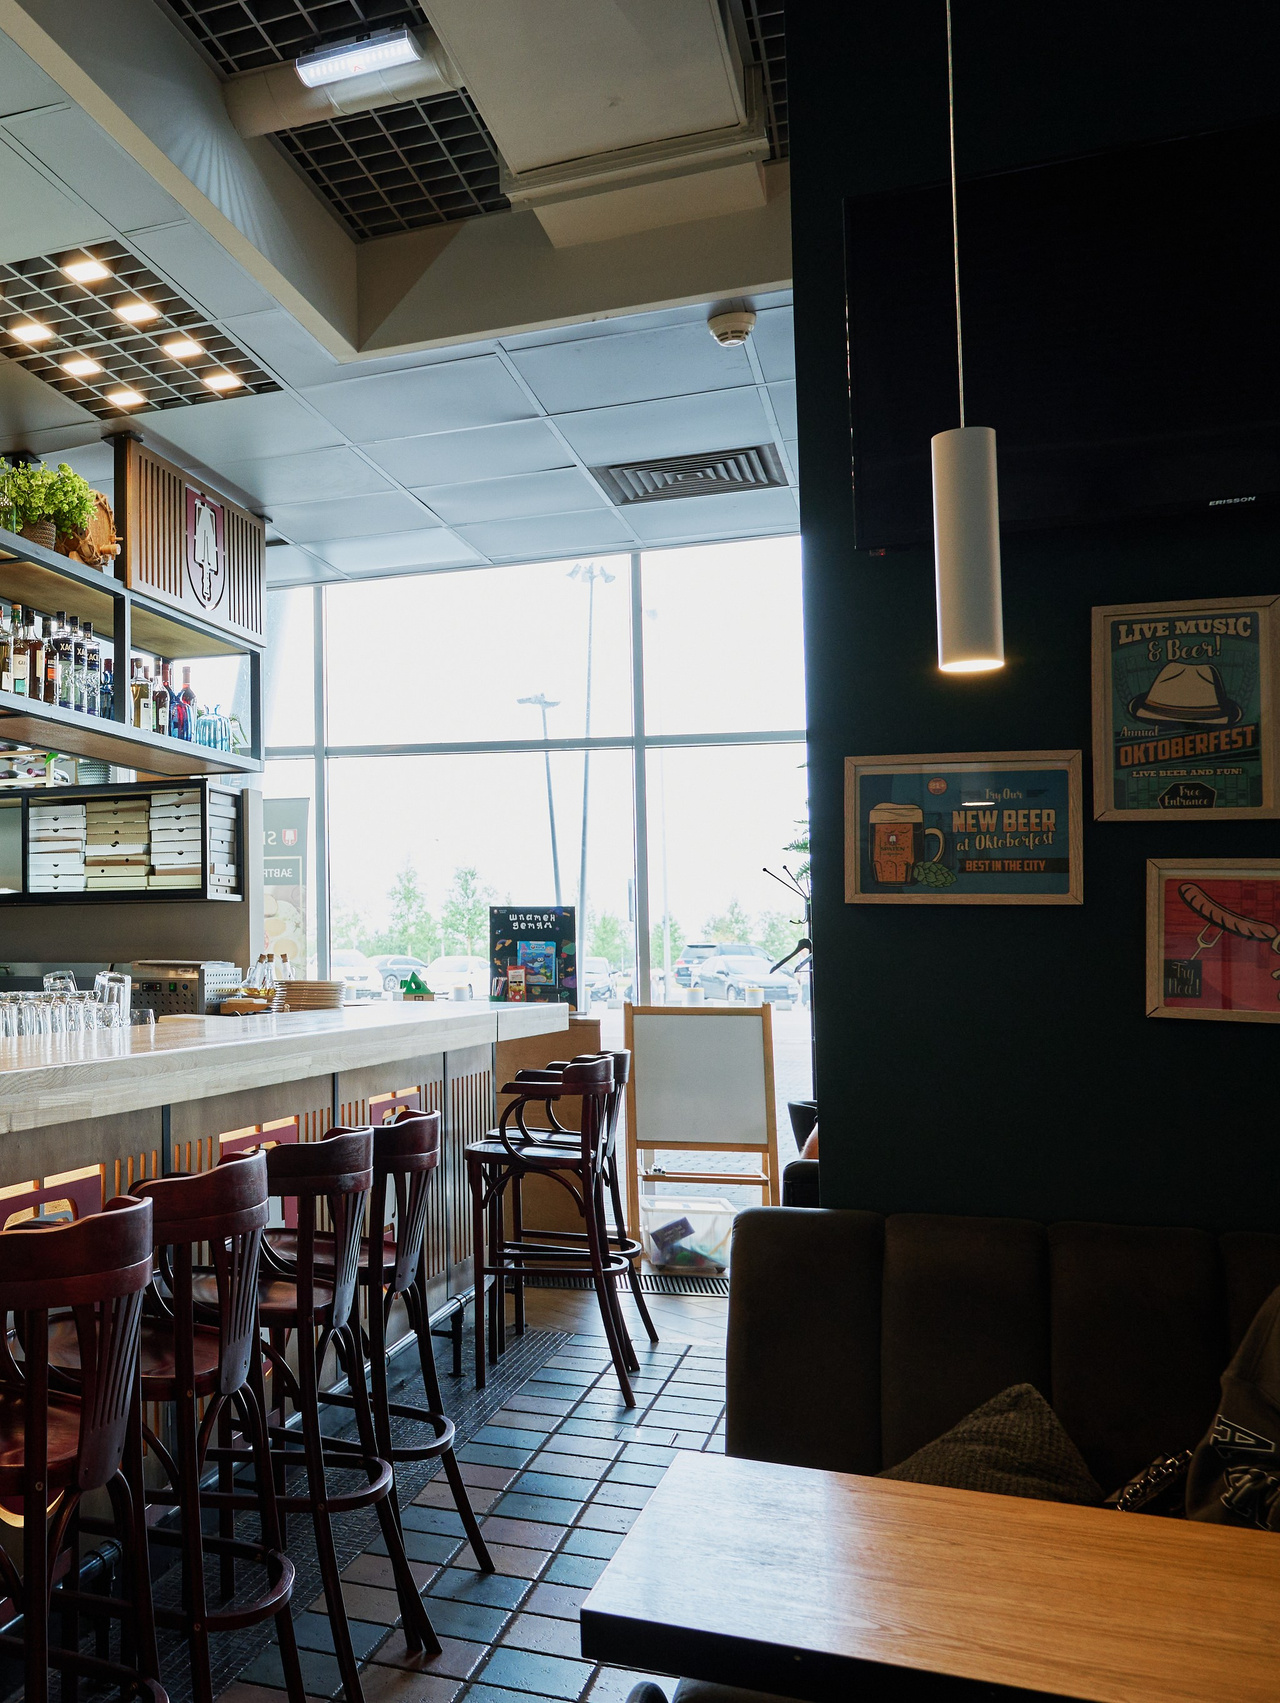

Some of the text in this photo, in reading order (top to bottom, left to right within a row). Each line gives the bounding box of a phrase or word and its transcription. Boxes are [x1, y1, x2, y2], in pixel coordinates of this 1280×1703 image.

[1209, 496, 1256, 506] ERISSON
[1118, 616, 1252, 645] LIVE MUSIC
[1148, 635, 1222, 662] & Beer!
[1120, 725, 1159, 737] Annual
[1120, 725, 1255, 767] OKTOBERFEST
[1159, 769, 1187, 777] BEER
[984, 788, 1023, 802] Try Our
[1179, 785, 1200, 796] Free
[1164, 795, 1209, 807] Entrance
[952, 809, 1056, 833] NEW BEER
[956, 832, 1053, 851] at Oktoberfest
[965, 860, 1046, 872] BEST IN THE CITY
